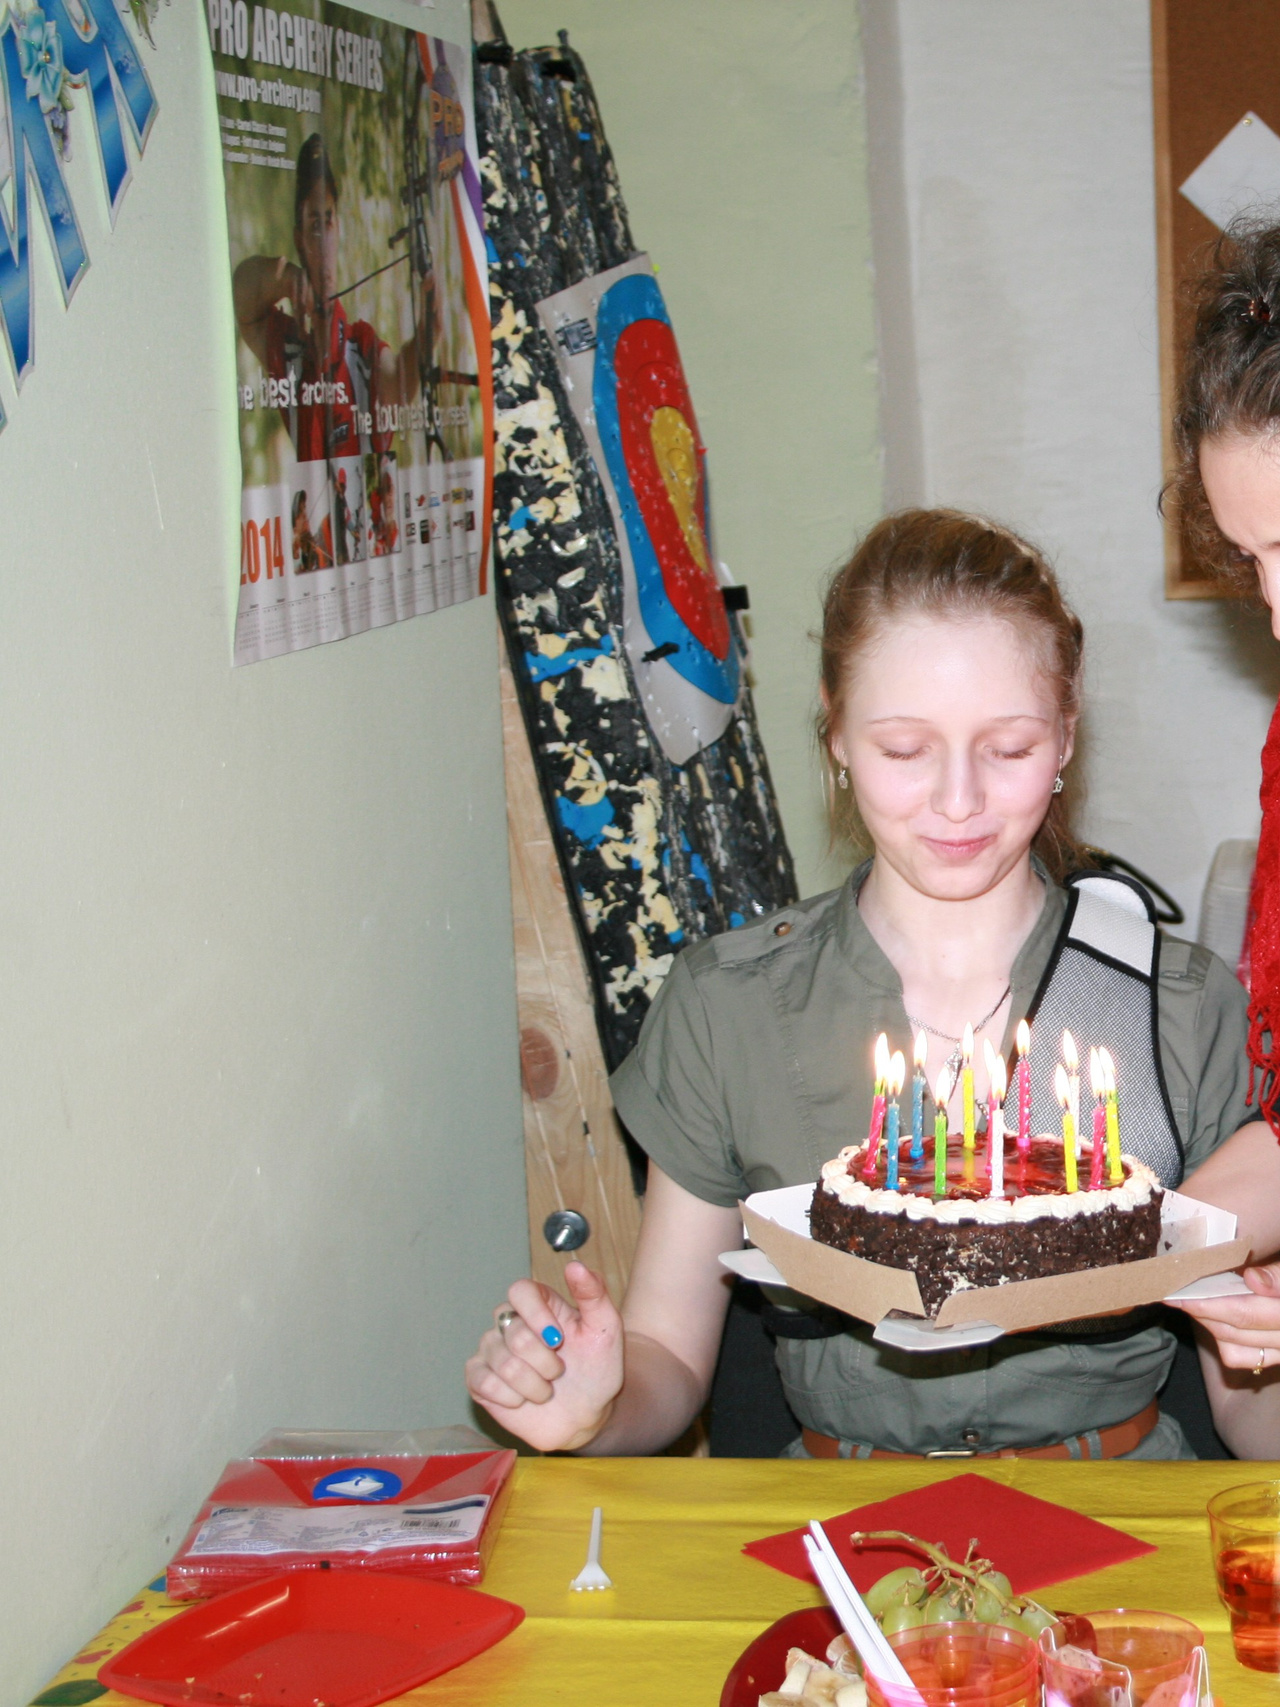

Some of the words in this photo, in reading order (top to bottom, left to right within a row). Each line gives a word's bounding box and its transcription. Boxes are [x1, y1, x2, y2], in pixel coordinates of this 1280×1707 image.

[208, 0, 249, 59] PRO
[252, 5, 333, 78] ARCHERY
[335, 28, 384, 92] SERIES
[258, 365, 298, 408] best
[302, 372, 349, 406] archers.
[350, 404, 373, 435] The
